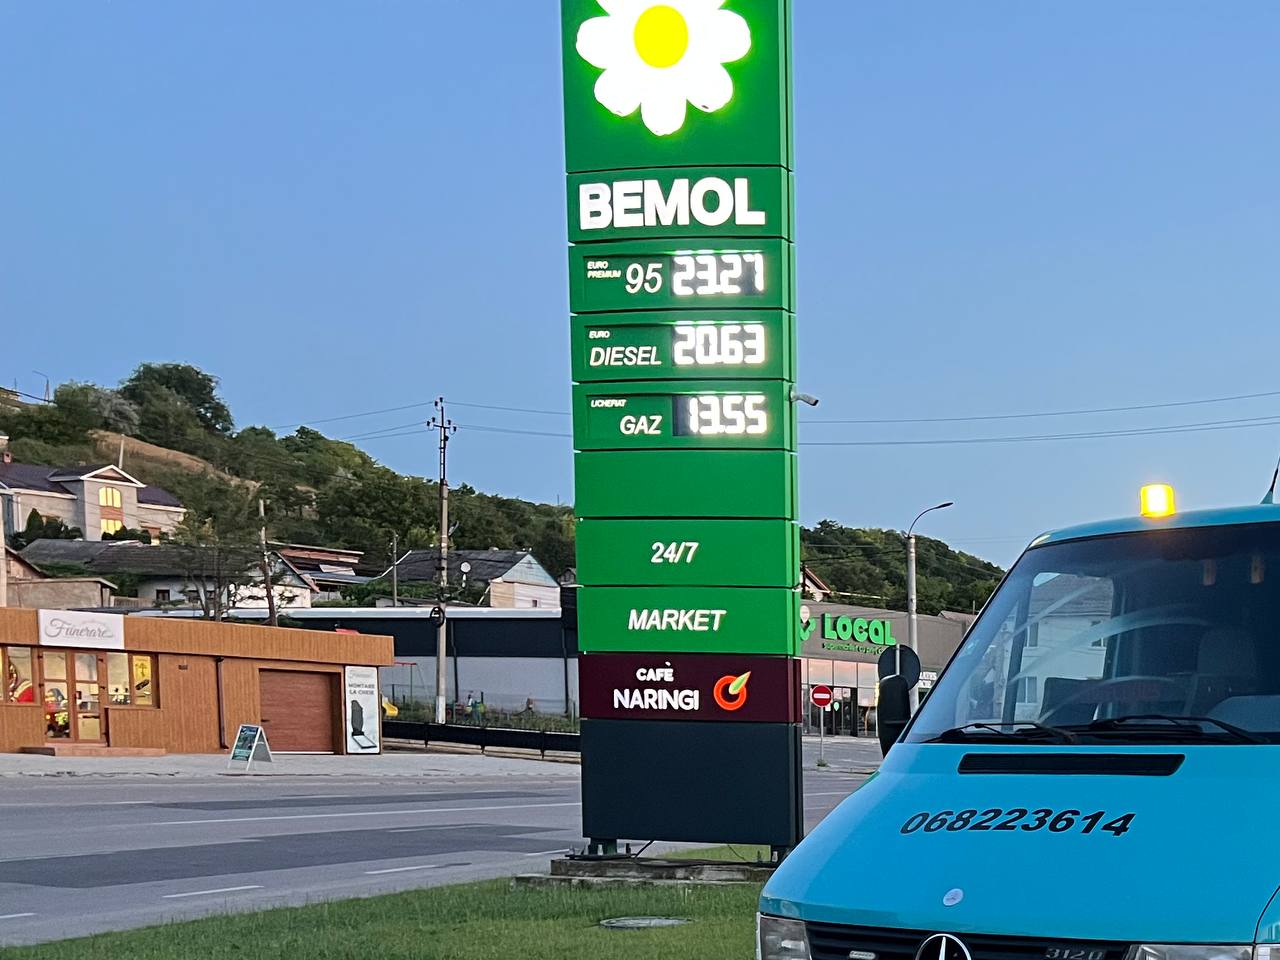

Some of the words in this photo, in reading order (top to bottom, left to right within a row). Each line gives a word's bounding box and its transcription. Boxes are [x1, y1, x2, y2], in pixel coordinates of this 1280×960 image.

[579, 176, 766, 231] BEMOL
[587, 260, 609, 270] EURO
[587, 270, 622, 279] PREMIUM
[625, 263, 662, 294] 95
[589, 330, 611, 339] EURO
[589, 345, 662, 367] DIESEL
[619, 415, 663, 435] GAZ
[650, 541, 700, 564] 24/7
[627, 608, 727, 632] MARKET
[613, 688, 700, 711] NARINGI
[900, 807, 1137, 837] 068223614
